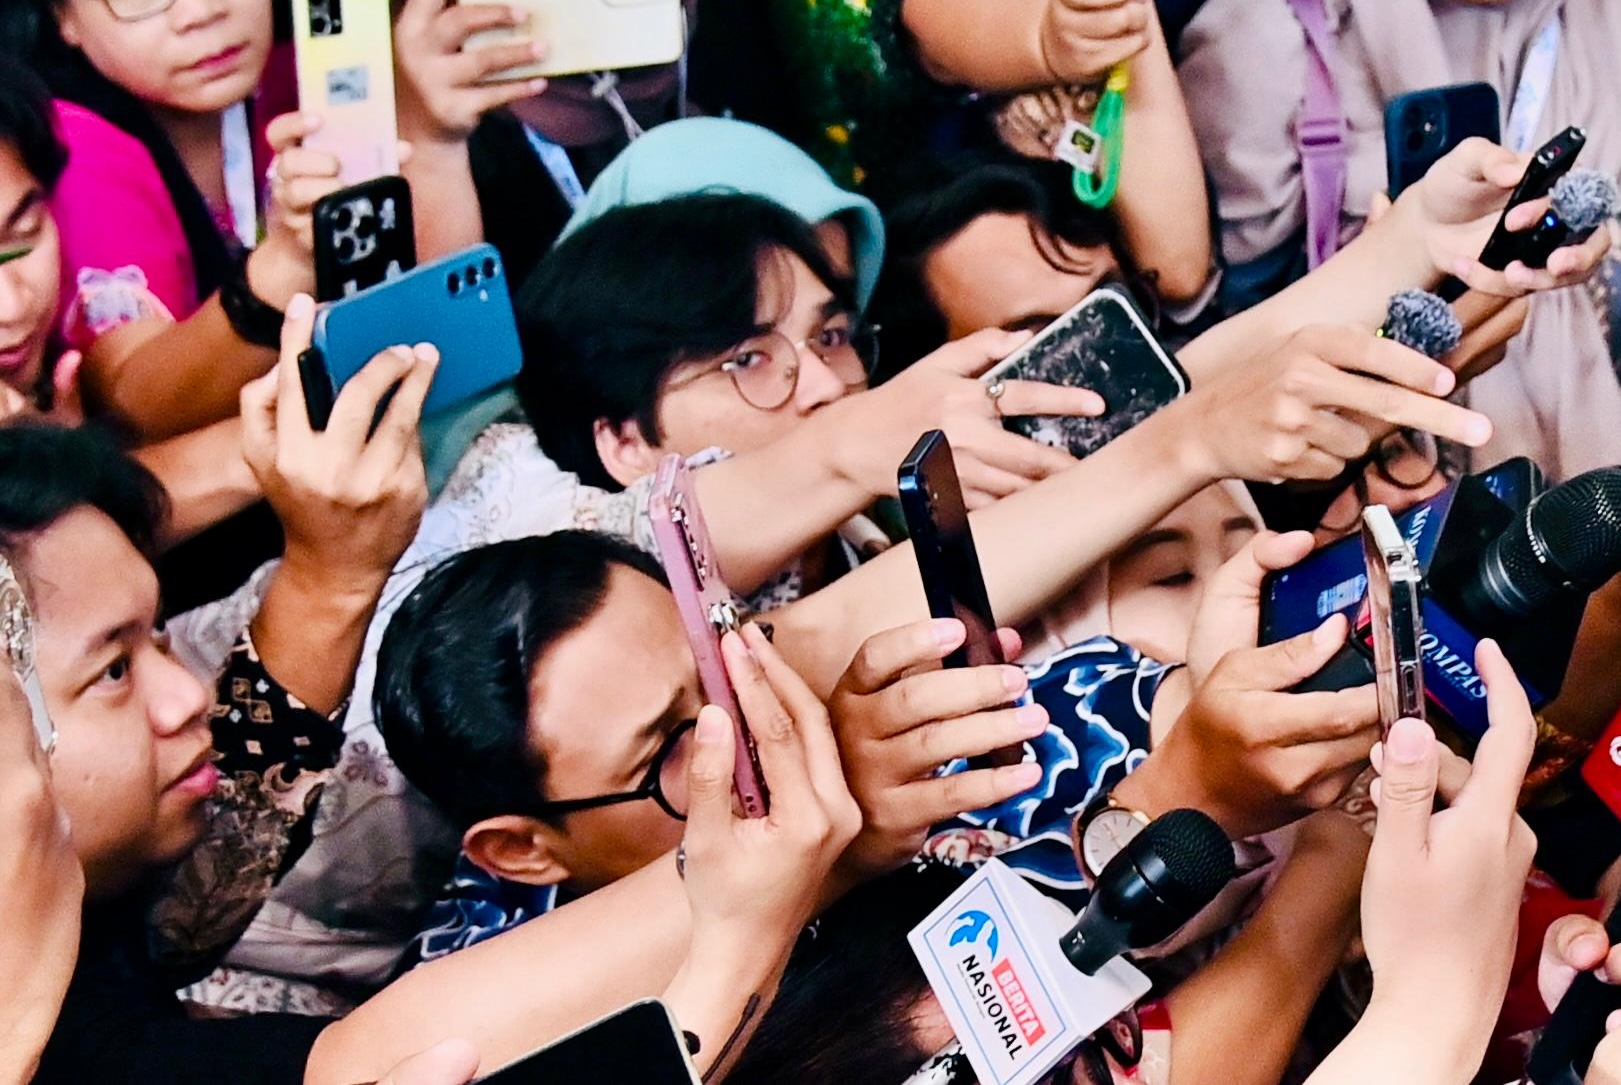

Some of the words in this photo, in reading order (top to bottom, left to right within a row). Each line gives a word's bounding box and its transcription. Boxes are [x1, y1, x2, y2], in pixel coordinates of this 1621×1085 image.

[1418, 630, 1488, 699] OMPAS
[962, 953, 1023, 1061] NASIONAL
[998, 970, 1038, 1037] BERITA
